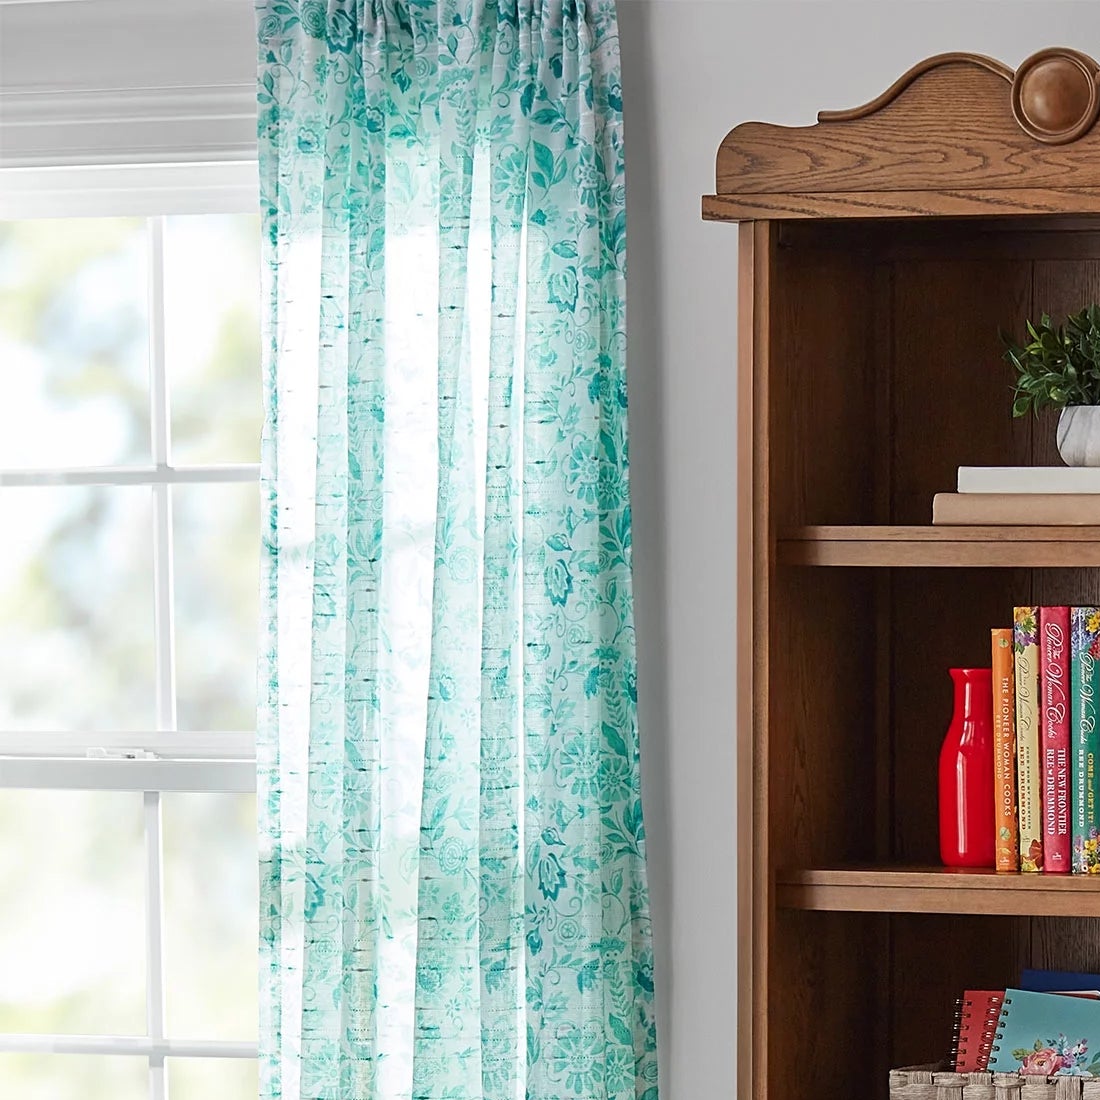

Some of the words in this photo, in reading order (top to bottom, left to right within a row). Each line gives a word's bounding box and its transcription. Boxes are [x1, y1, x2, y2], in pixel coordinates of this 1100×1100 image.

[1044, 622, 1064, 663] Pioneer
[1046, 663, 1066, 705] Woman
[1078, 652, 1095, 684] Pioneer
[1002, 698, 1010, 738] PIONEER
[1080, 684, 1096, 719] Woman
[1046, 702, 1066, 739] Cooks
[1079, 716, 1096, 745] Cooks
[1003, 742, 1011, 780] WOMAN
[1046, 748, 1055, 768] REE
[1057, 748, 1066, 768] THE
[1057, 768, 1066, 788] NEW
[1046, 776, 1055, 835] DRUMMOND
[1058, 790, 1067, 835] FRONTIER
